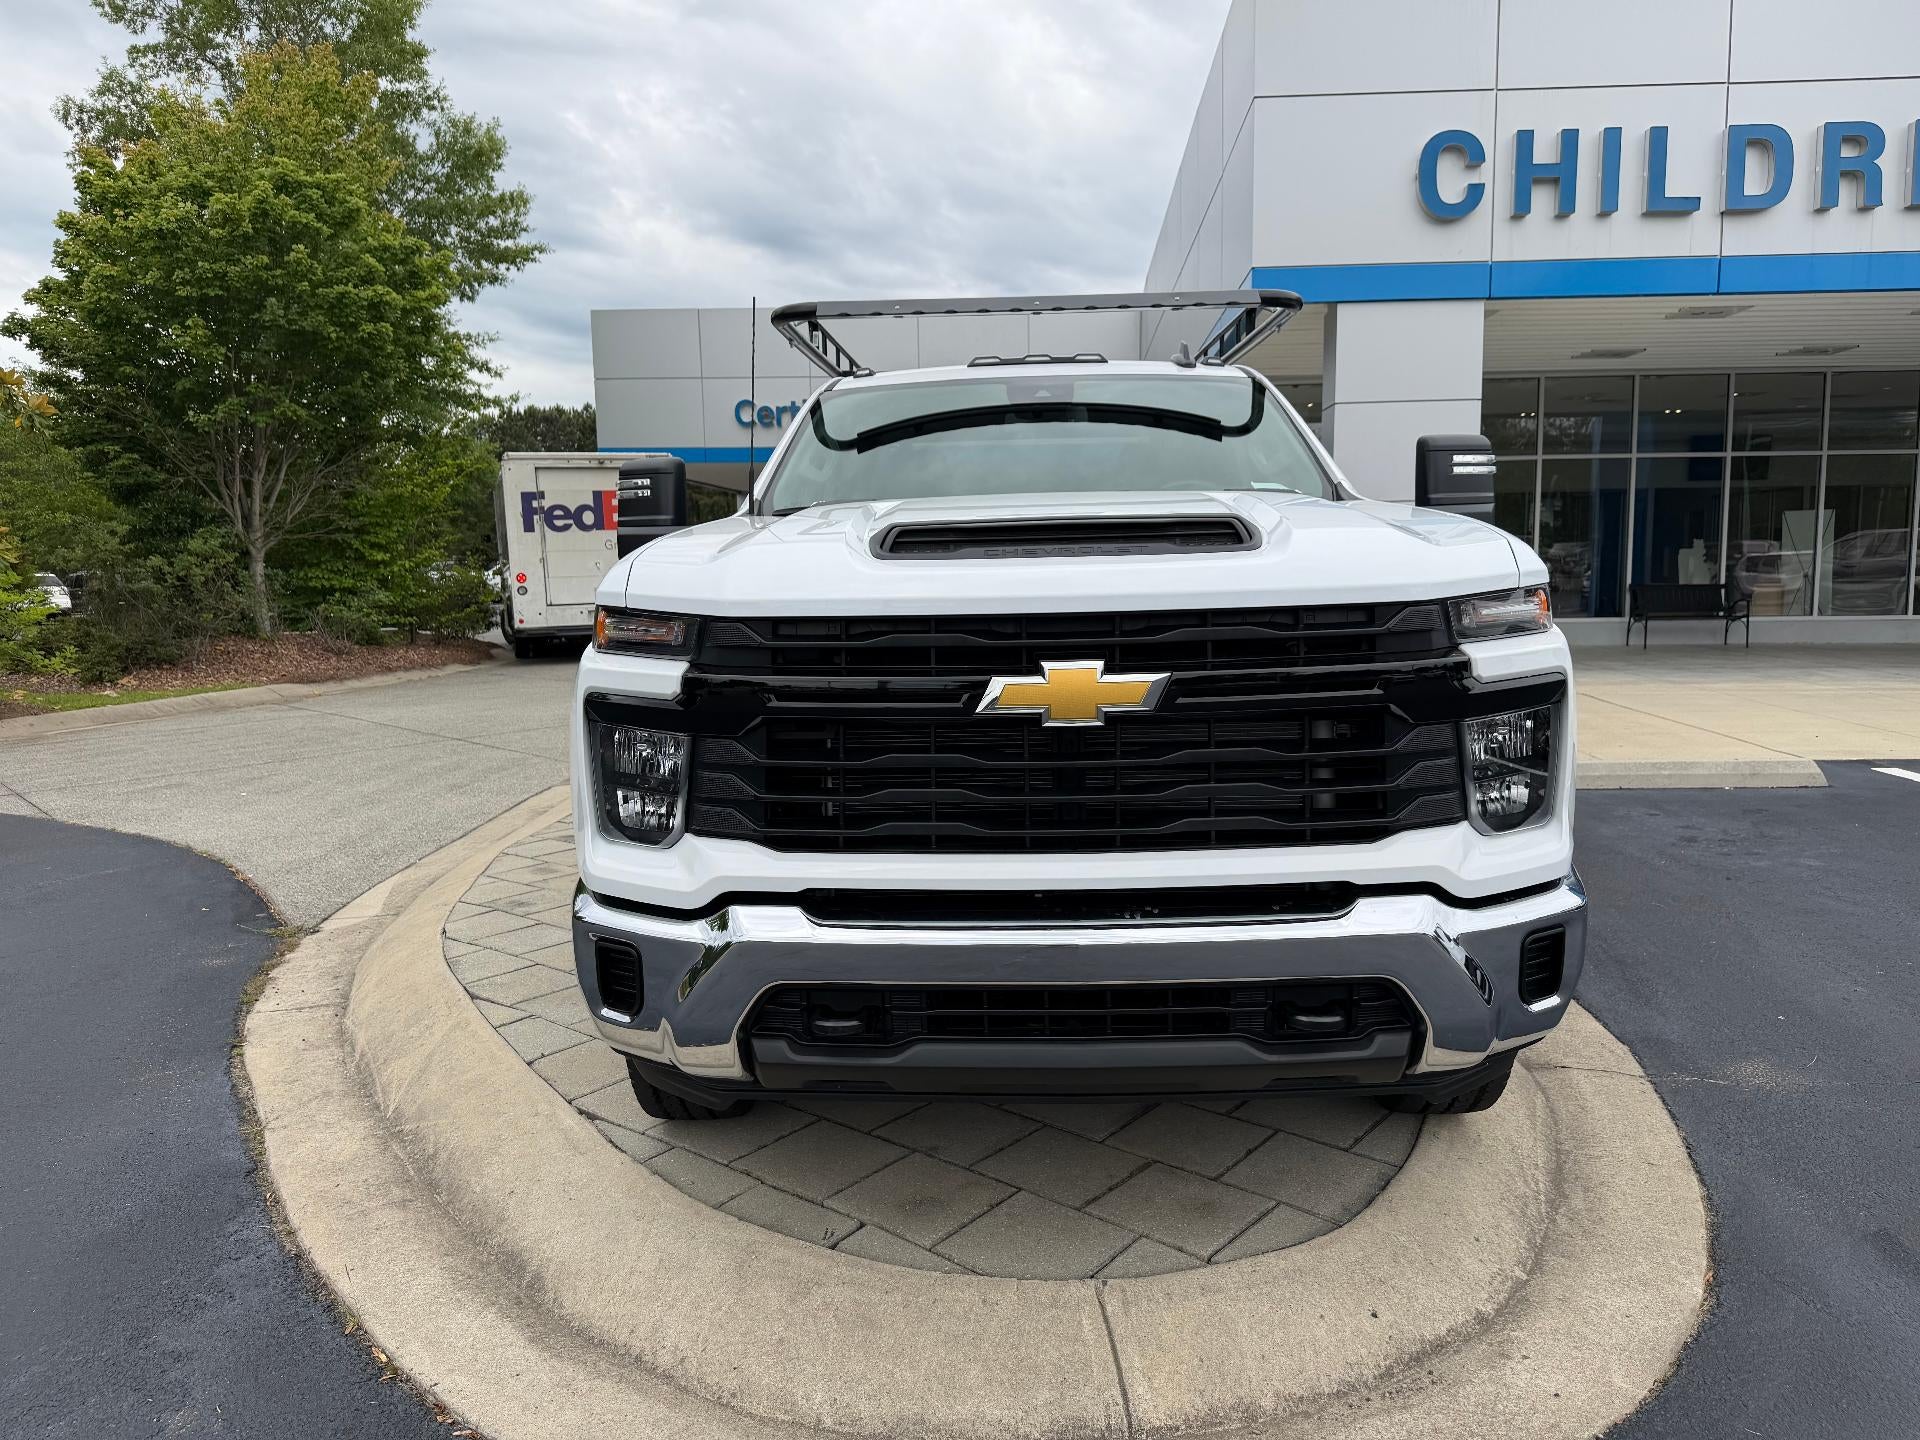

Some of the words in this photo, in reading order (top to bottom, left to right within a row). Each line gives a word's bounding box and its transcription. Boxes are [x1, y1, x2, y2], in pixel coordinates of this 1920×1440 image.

[1416, 119, 1920, 221] CHILDR
[735, 399, 806, 429] Cert
[520, 490, 618, 532] FedE
[983, 545, 1150, 559] CHEVROLET
